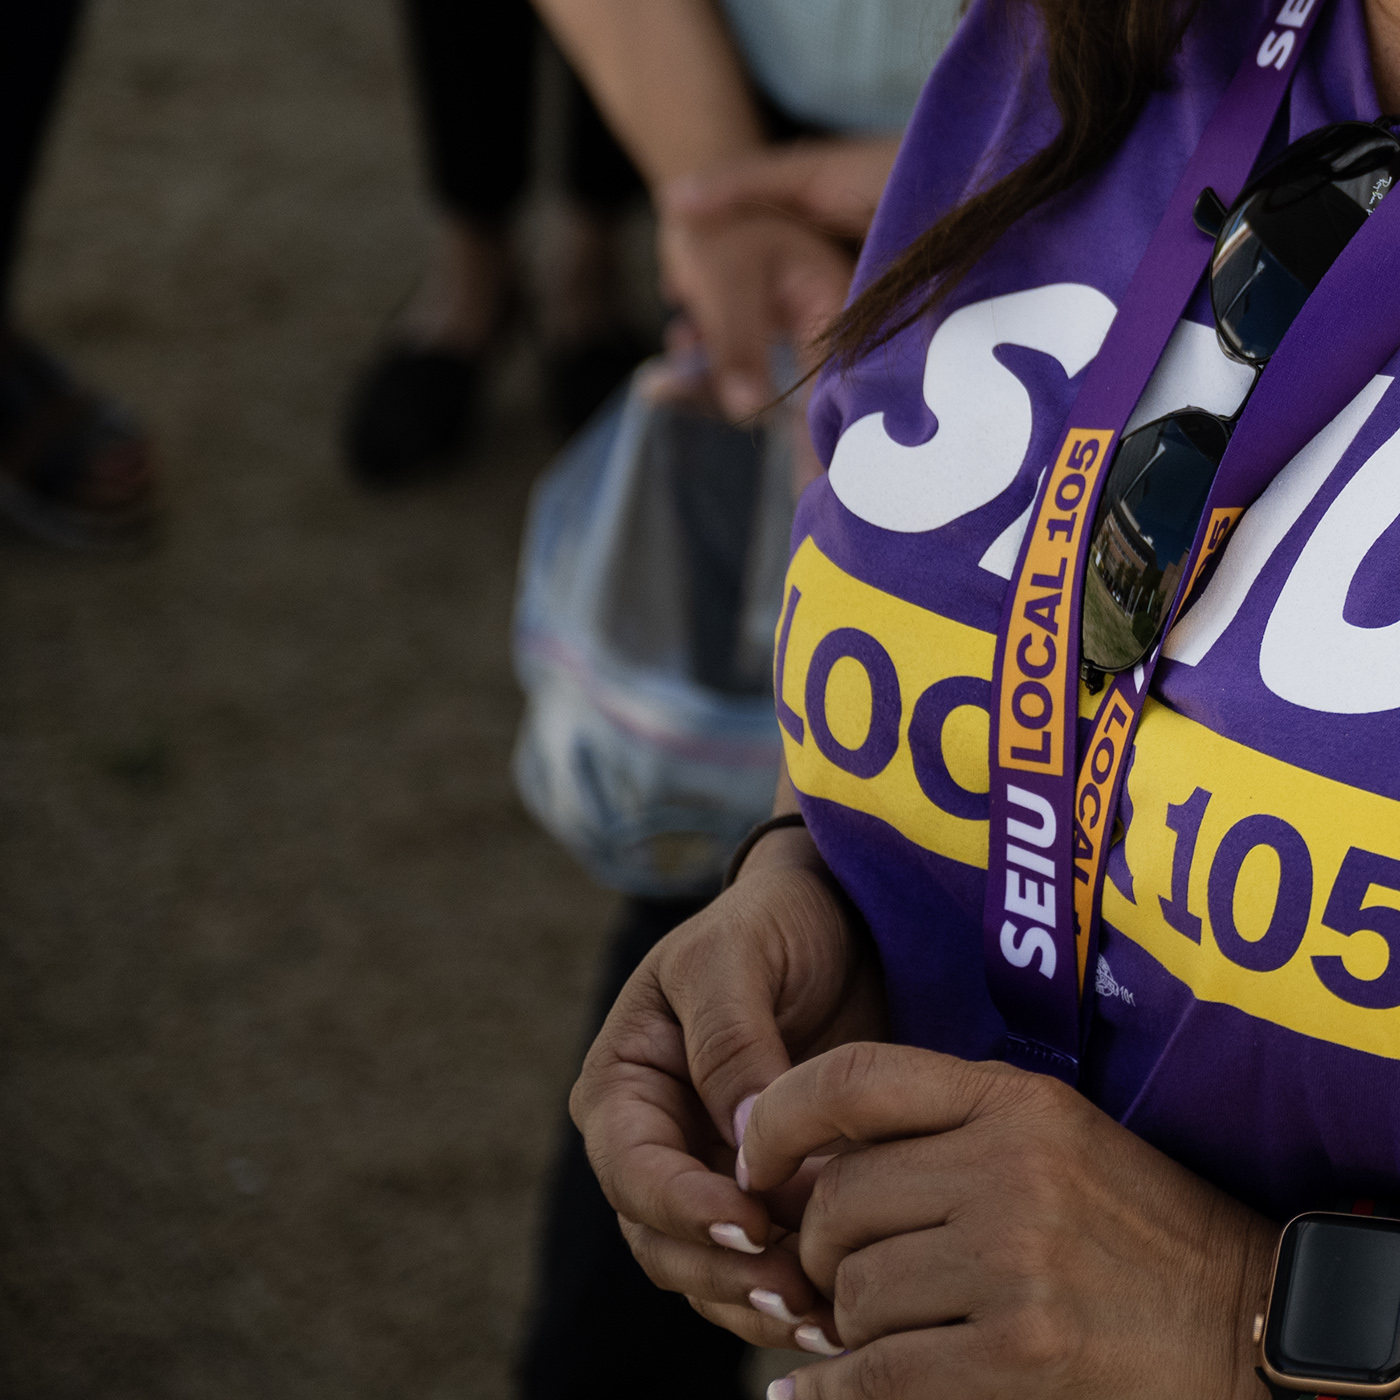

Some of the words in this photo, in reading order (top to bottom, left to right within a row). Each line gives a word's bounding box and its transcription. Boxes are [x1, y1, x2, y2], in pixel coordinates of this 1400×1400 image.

[1046, 438, 1100, 543] 105
[1011, 557, 1067, 765] LOCAL
[1000, 784, 1057, 980] SEIU
